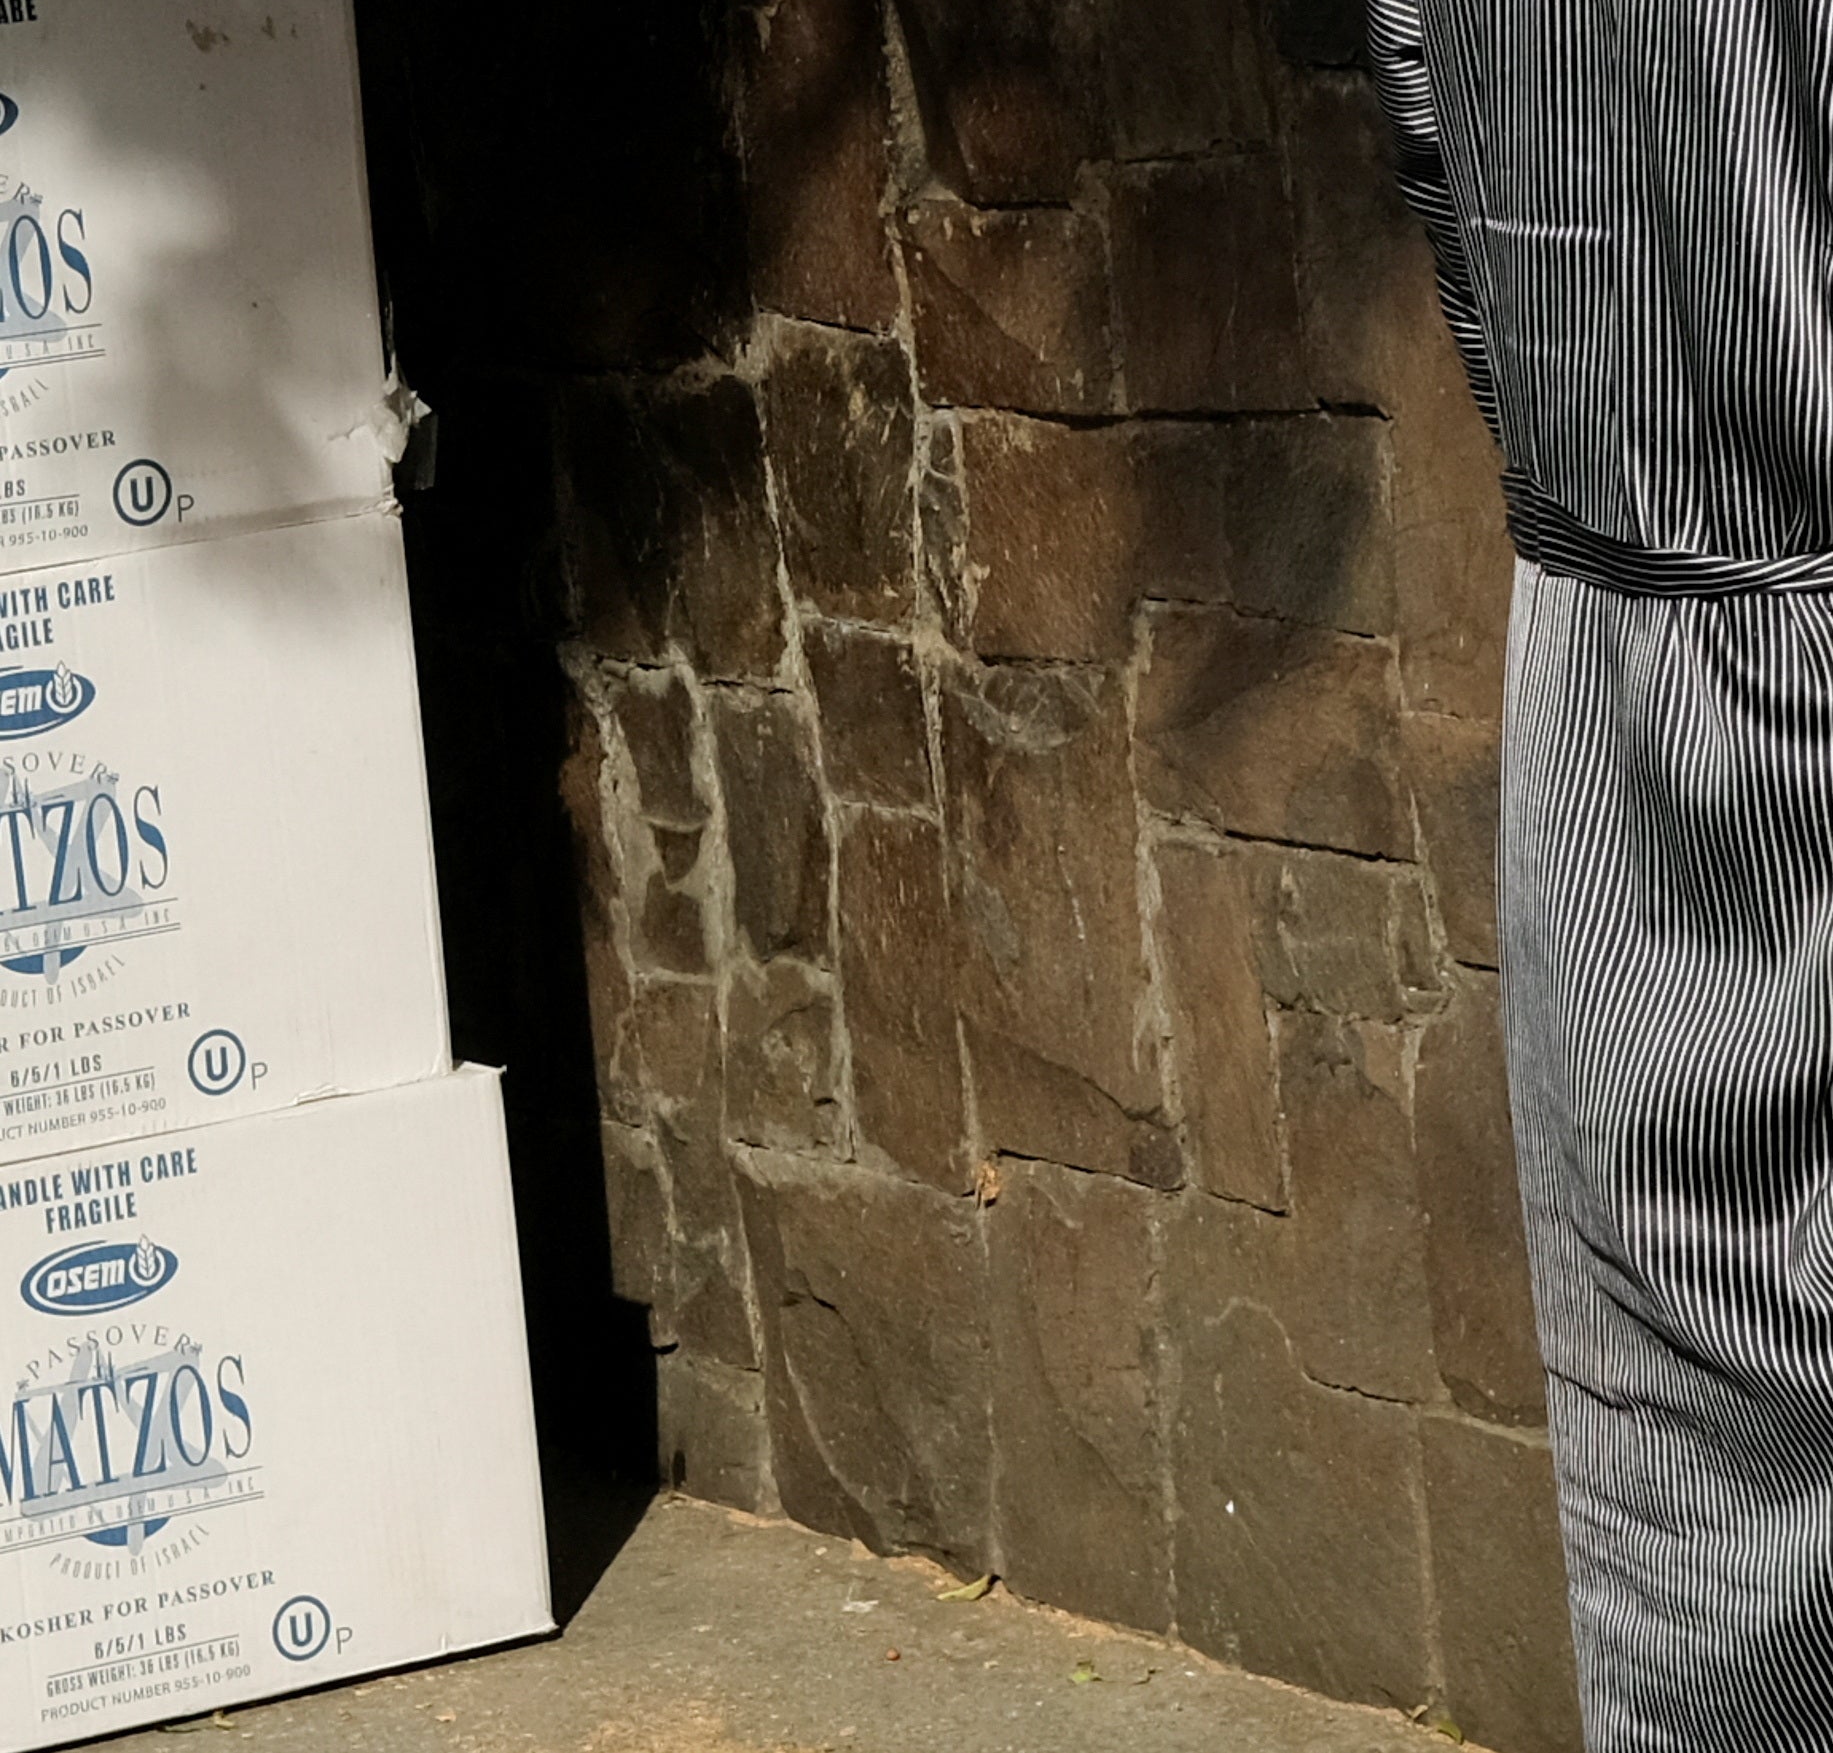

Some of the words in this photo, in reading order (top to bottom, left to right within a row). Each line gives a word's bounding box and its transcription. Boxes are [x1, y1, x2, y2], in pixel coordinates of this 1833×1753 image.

[58, 575, 115, 609] CARE
[0, 785, 168, 914] TZOS
[47, 985, 62, 1004] OF
[20, 1026, 64, 1049] FOR
[73, 1002, 191, 1038] PASSOVER
[11, 1061, 60, 1088] 6/5/1
[70, 1054, 102, 1076] LBS
[74, 1083, 95, 1103] LBS
[28, 1111, 86, 1135] NUMBER
[71, 1160, 131, 1196] WITH
[140, 1148, 197, 1183] CARE
[45, 1192, 137, 1234] FRAGILE
[46, 1258, 125, 1298] OSEM
[26, 1324, 191, 1380] PASSOVER
[0, 1354, 252, 1507] MATZOS
[50, 1552, 120, 1580] PRODUCT
[131, 1556, 146, 1575] OF
[0, 1609, 94, 1644] KOSHER
[103, 1597, 148, 1621] FOR
[158, 1570, 276, 1608] PASSOVER
[94, 1633, 145, 1659] 6/5/1
[155, 1623, 187, 1645] LBS
[46, 1675, 83, 1698] GROSS
[159, 1651, 179, 1672] LBS
[41, 1696, 107, 1723] PRODUCT
[112, 1682, 171, 1706] NUMBER
